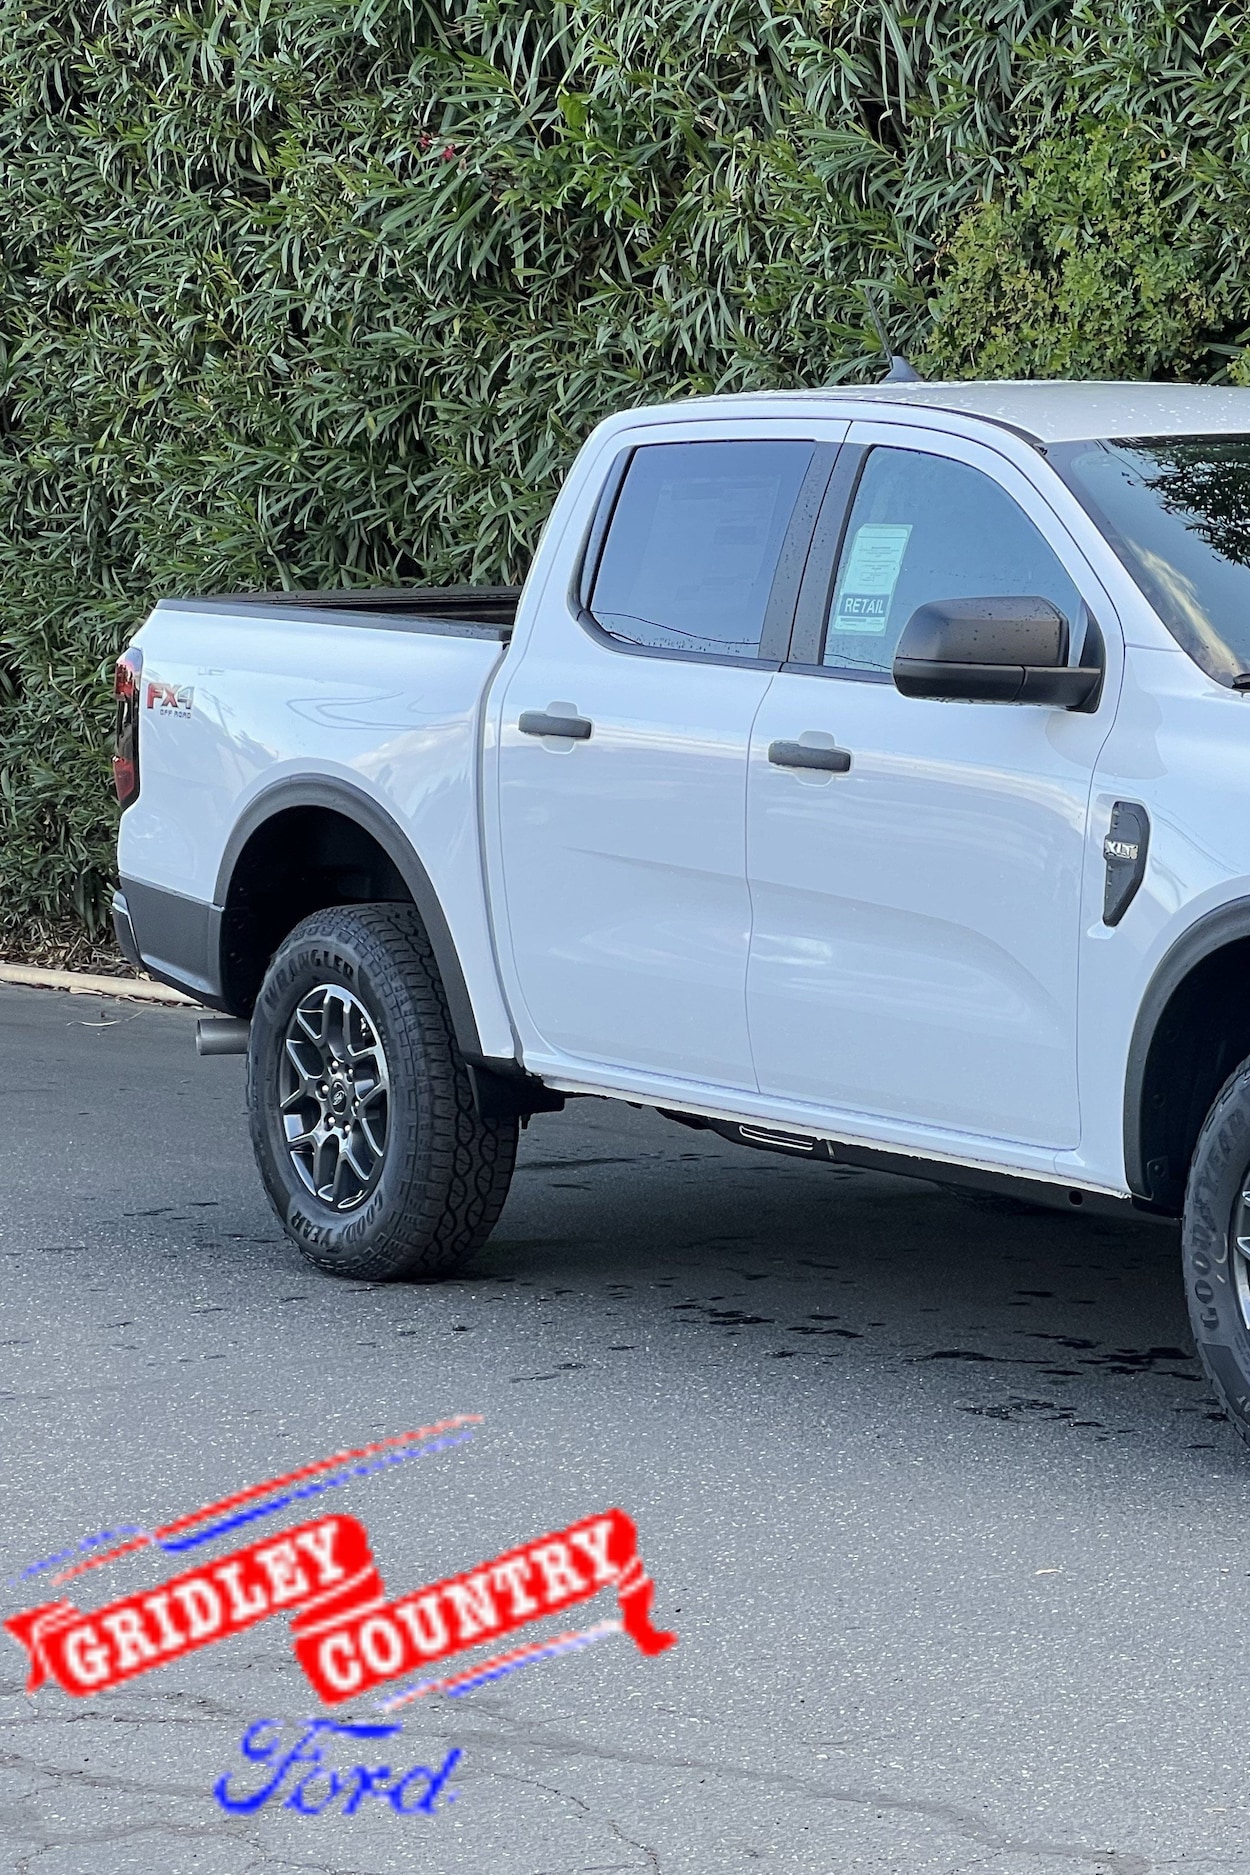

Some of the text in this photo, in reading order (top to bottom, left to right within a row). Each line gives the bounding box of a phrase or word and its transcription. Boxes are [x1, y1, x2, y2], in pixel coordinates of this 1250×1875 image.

[844, 597, 884, 614] RETAIL
[147, 683, 194, 709] FX4
[174, 711, 191, 719] ROAD
[1106, 841, 1138, 859] XLT
[264, 949, 354, 1011] WRANGLER
[1191, 1108, 1248, 1331] GOODYEAR
